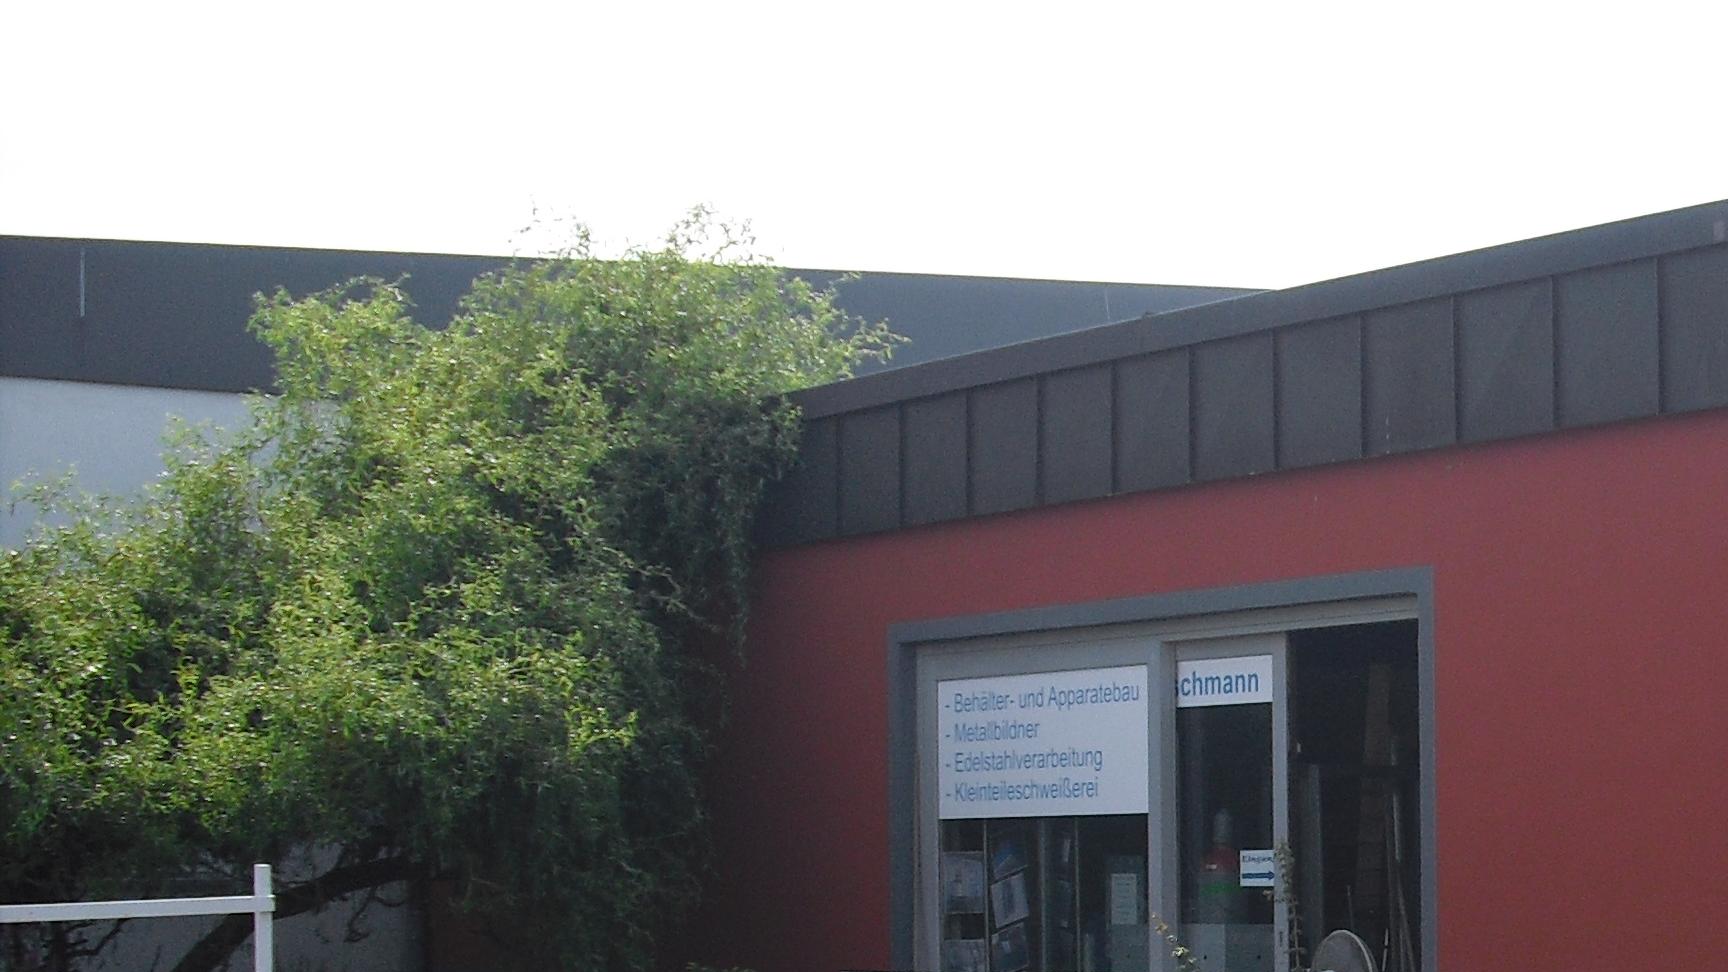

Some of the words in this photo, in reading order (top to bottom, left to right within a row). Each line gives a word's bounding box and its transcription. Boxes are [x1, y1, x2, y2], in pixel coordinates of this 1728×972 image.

[1176, 670, 1260, 697] chmann
[954, 689, 1015, 714] Behälter-
[1018, 686, 1045, 710] und
[1047, 681, 1140, 711] Apparatebau
[954, 721, 1041, 743] Metallbildner
[954, 747, 1103, 773] Edelstahlverarbeitung
[954, 776, 1100, 803] Kleinteileschweißerei
